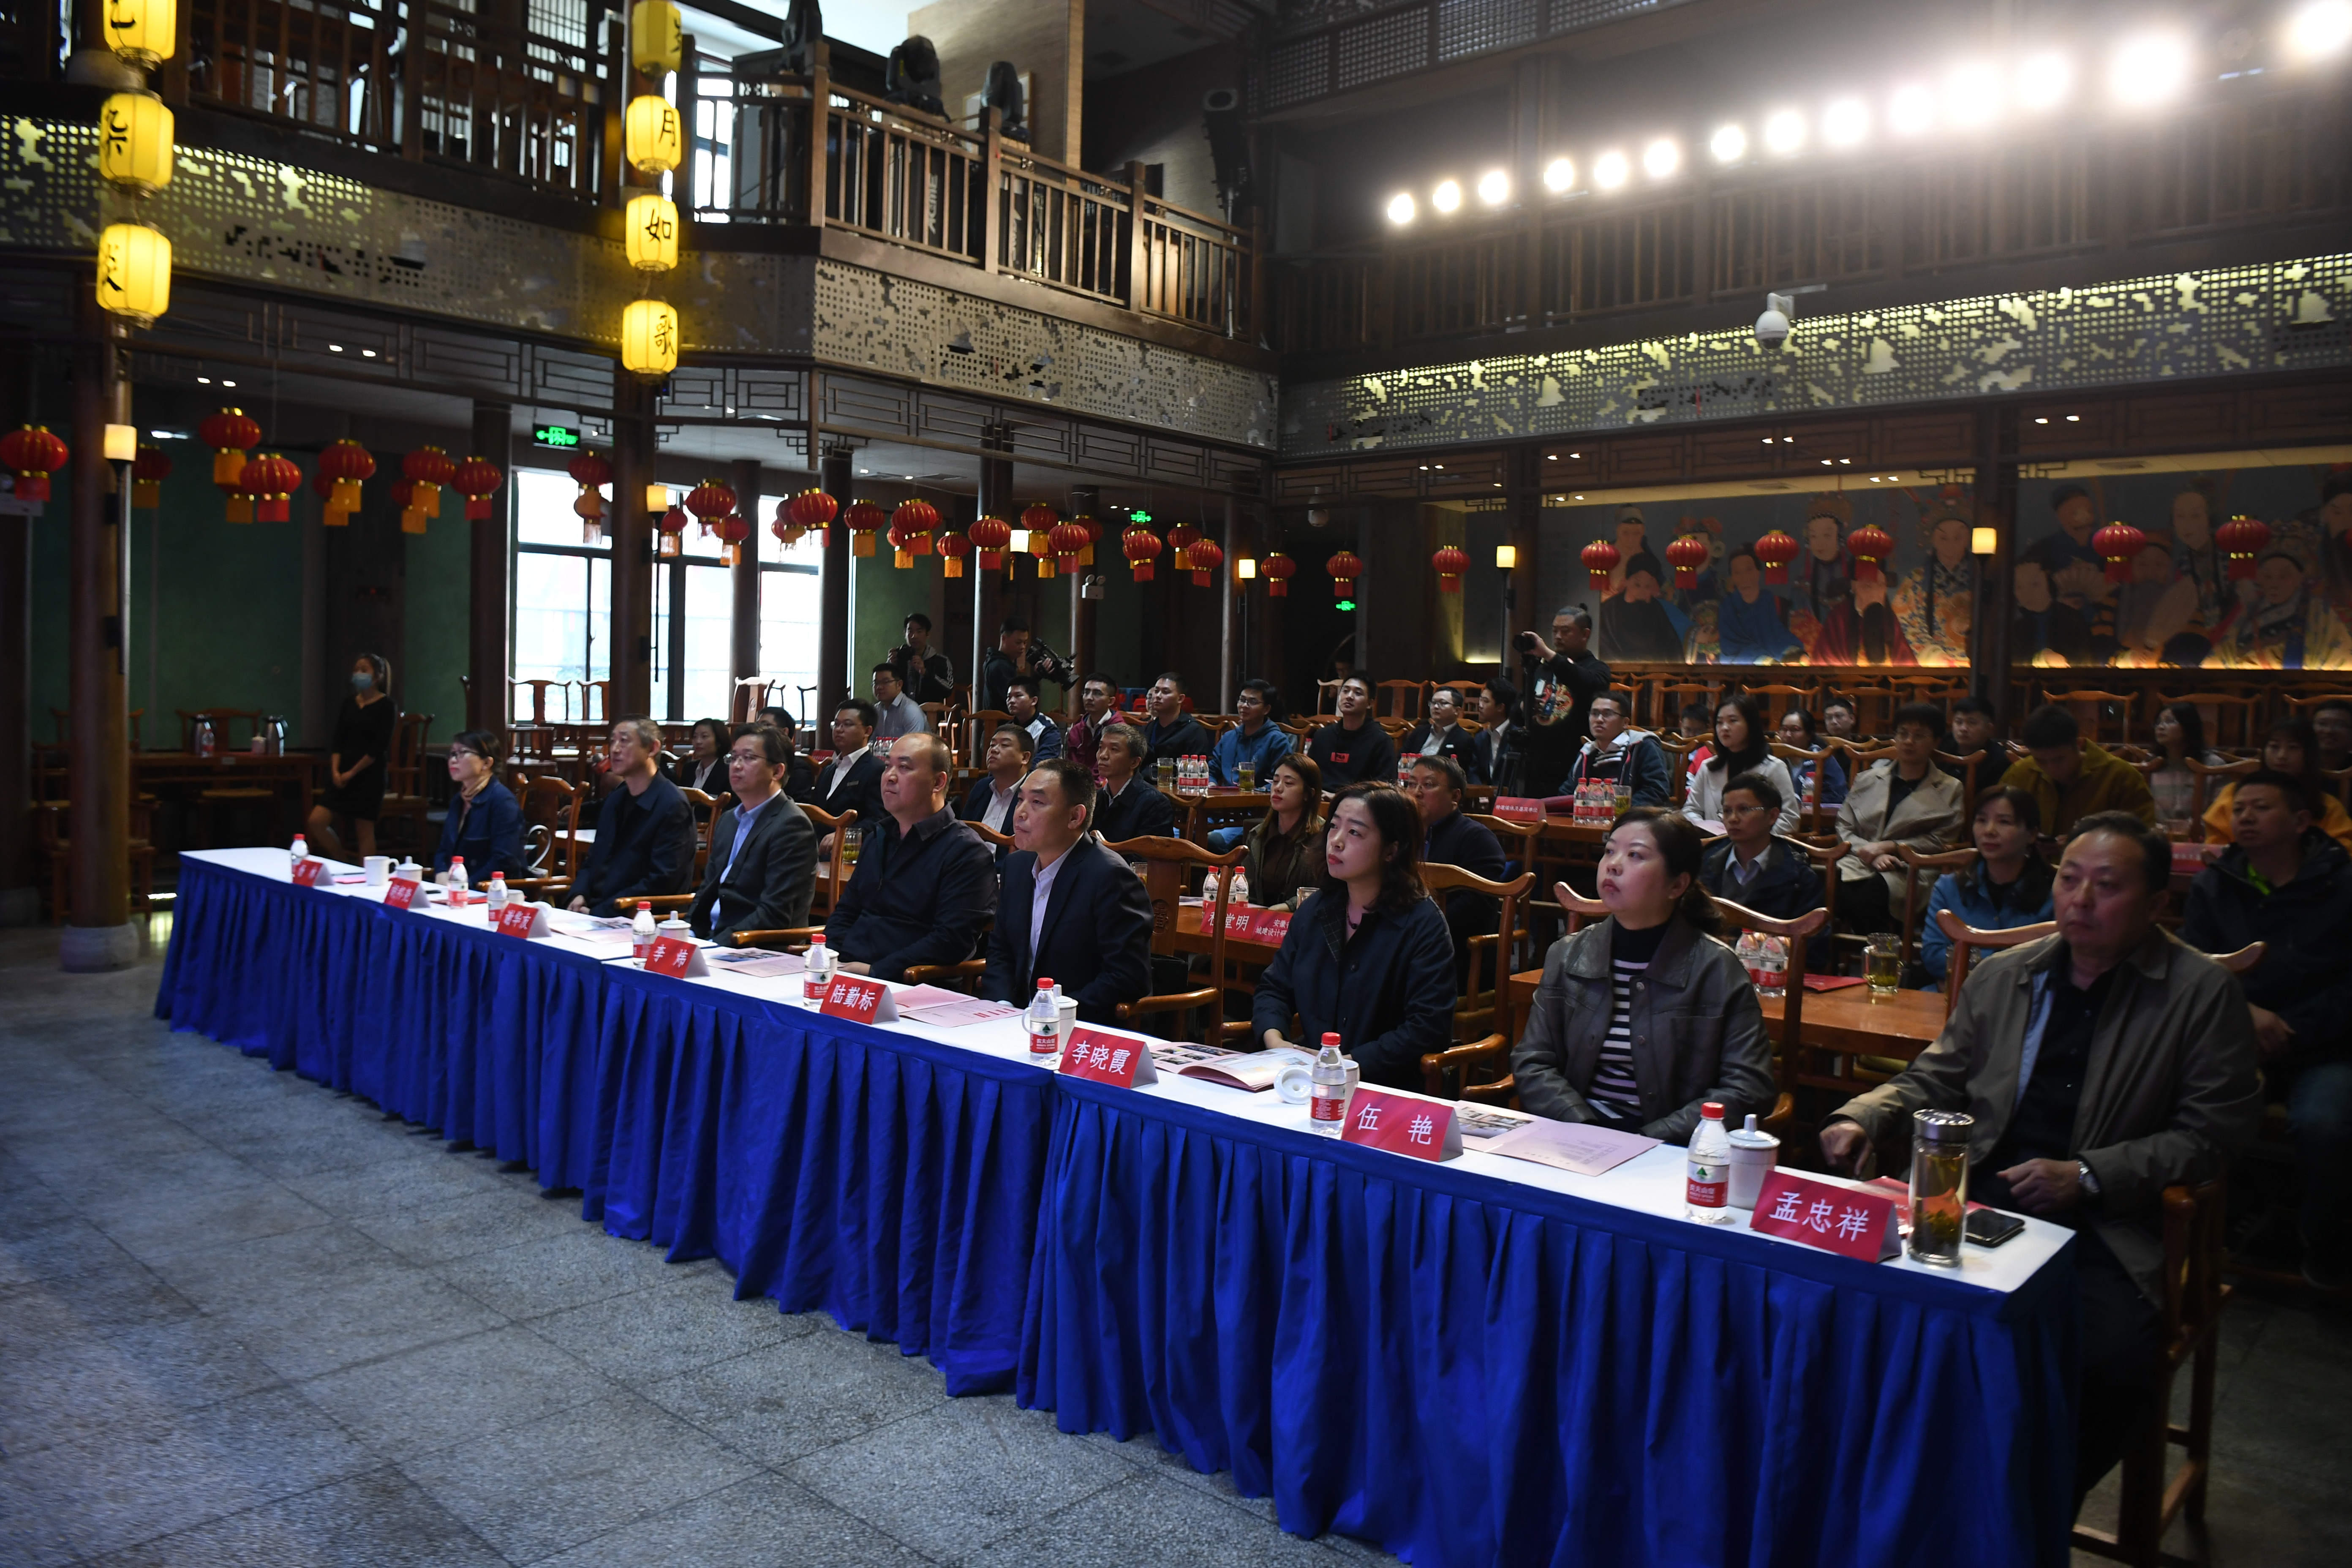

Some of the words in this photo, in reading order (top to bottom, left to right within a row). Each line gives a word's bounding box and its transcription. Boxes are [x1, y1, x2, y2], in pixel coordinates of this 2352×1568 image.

[645, 209, 671, 243] 如
[655, 315, 676, 356] 歌
[829, 983, 876, 1012] 陆勤标
[1072, 1040, 1131, 1075] 李晓霞
[1769, 1190, 1870, 1241] 孟忠祥
